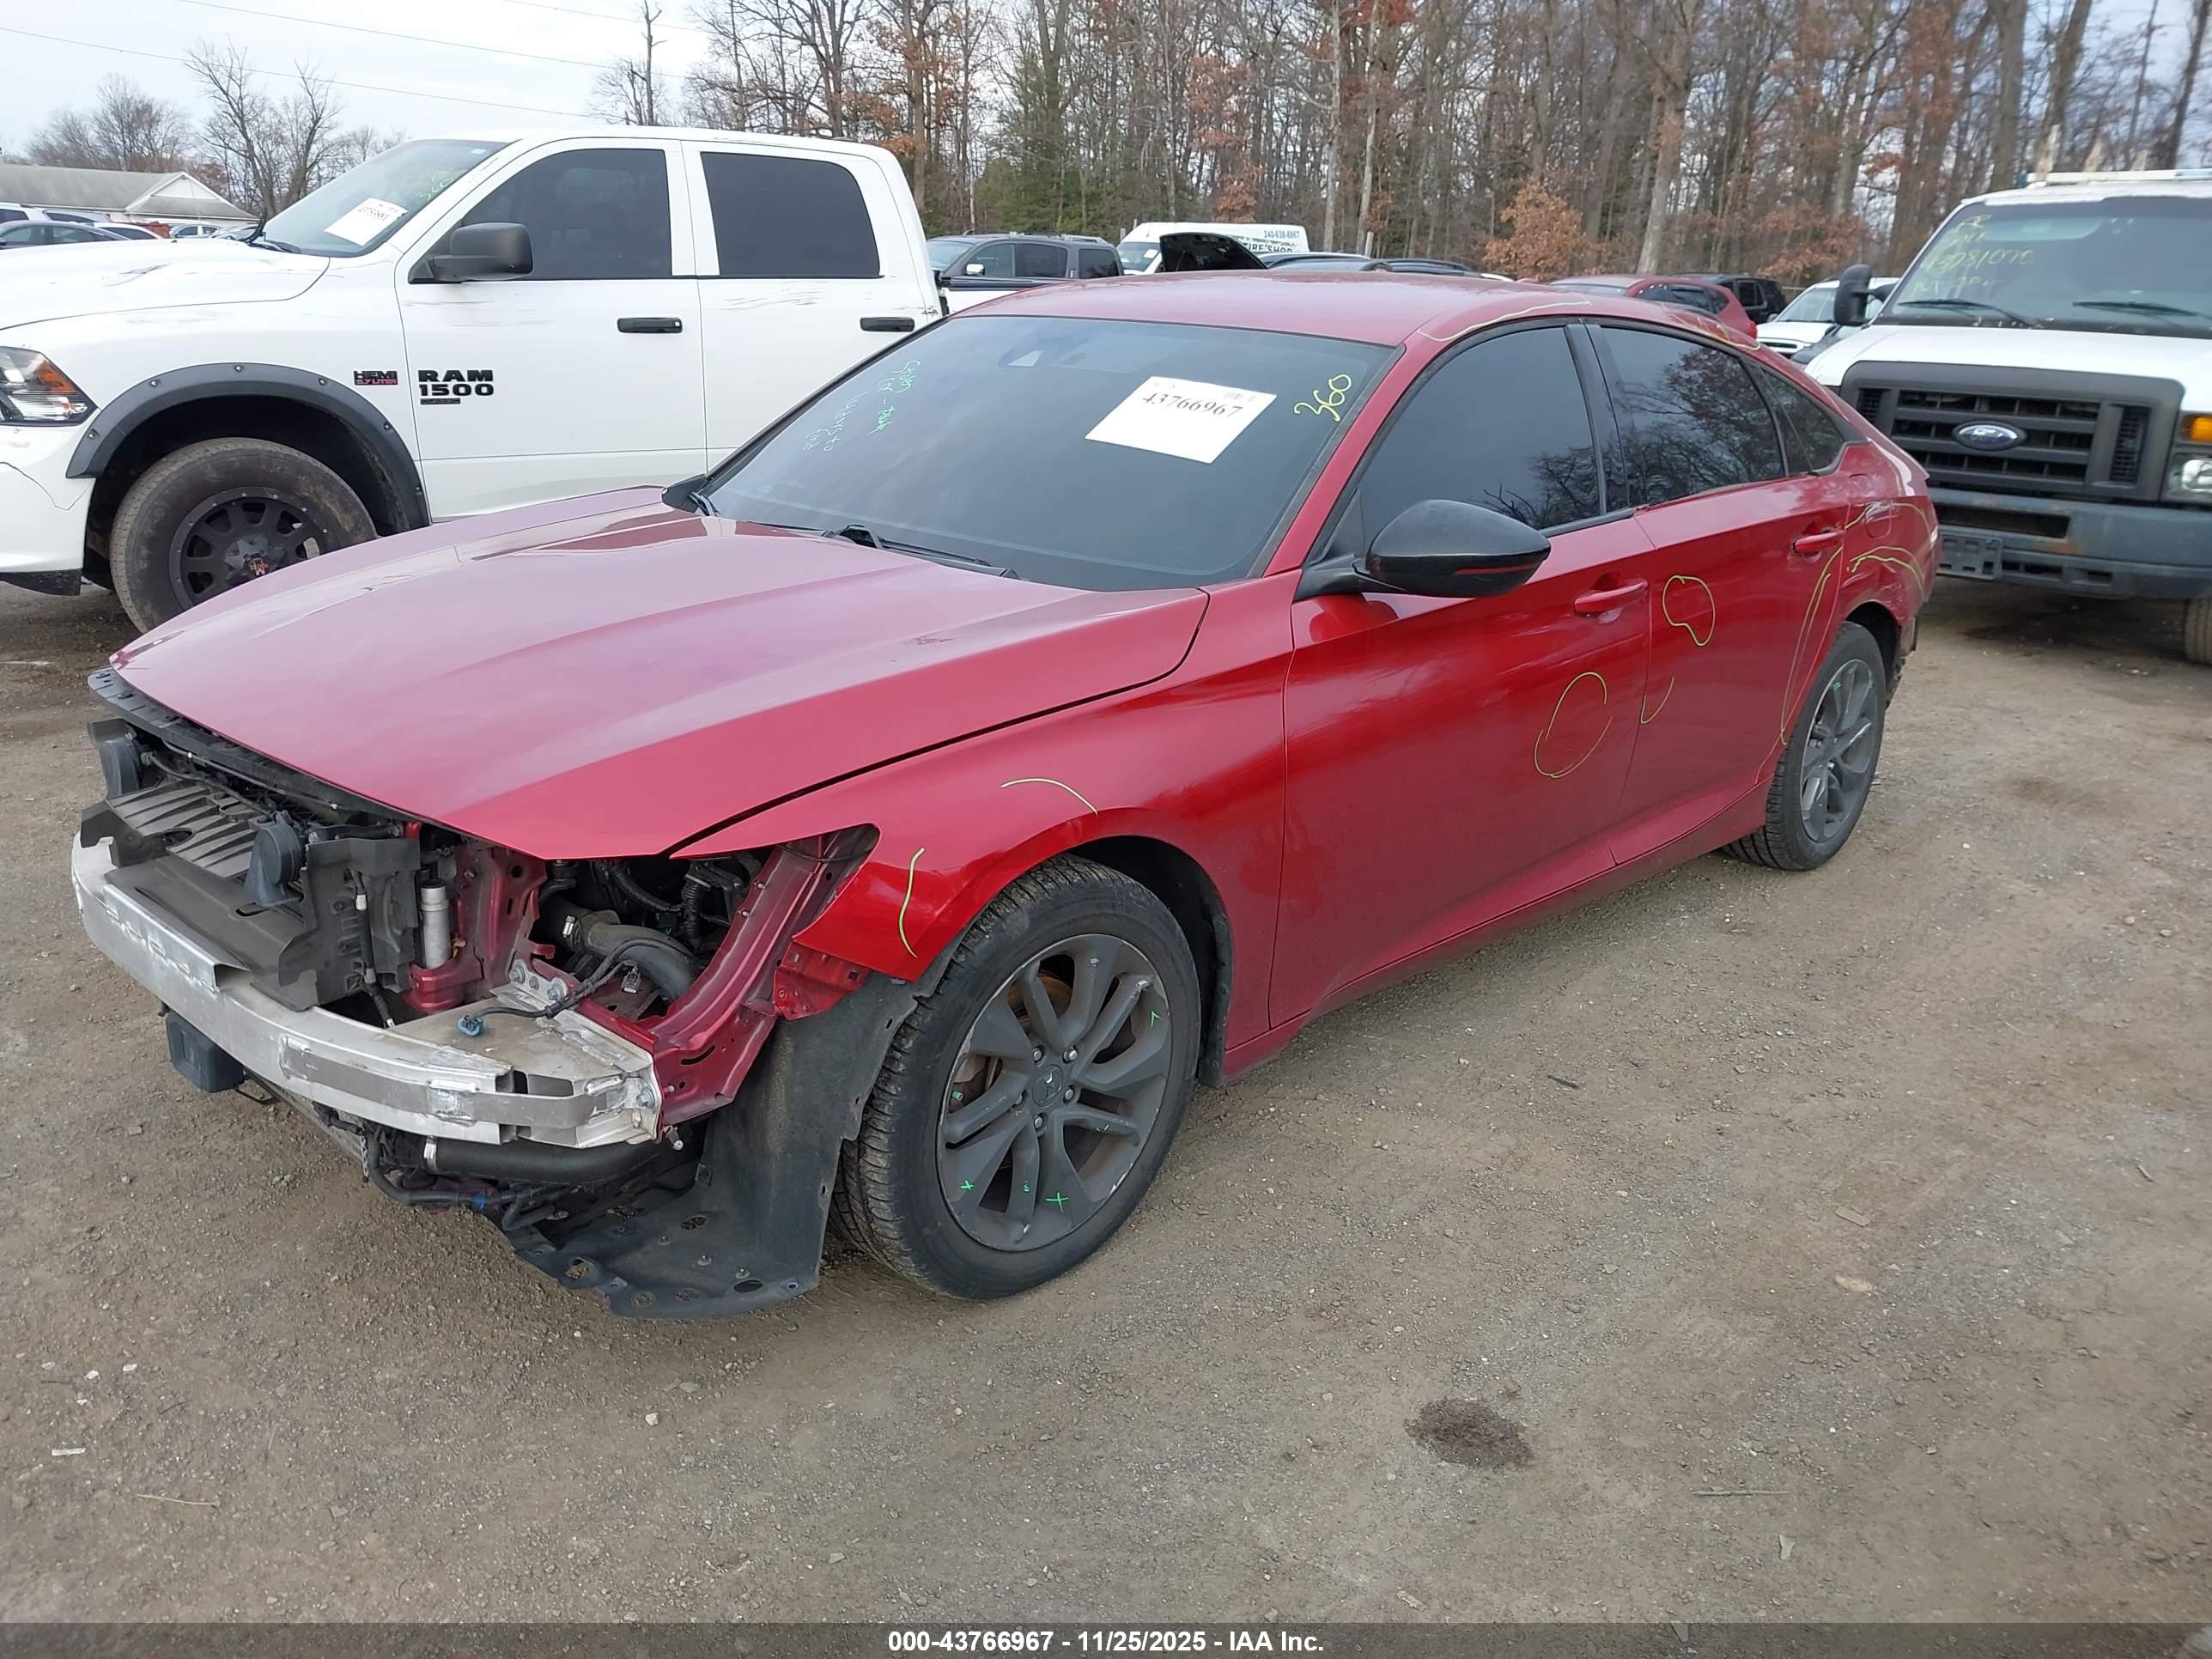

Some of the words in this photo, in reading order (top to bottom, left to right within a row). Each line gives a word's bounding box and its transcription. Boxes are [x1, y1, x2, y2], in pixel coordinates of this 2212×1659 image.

[417, 370, 494, 382] RAM
[418, 383, 494, 397] 1500
[1293, 374, 1352, 422] 360
[1142, 392, 1243, 417] 43766967
